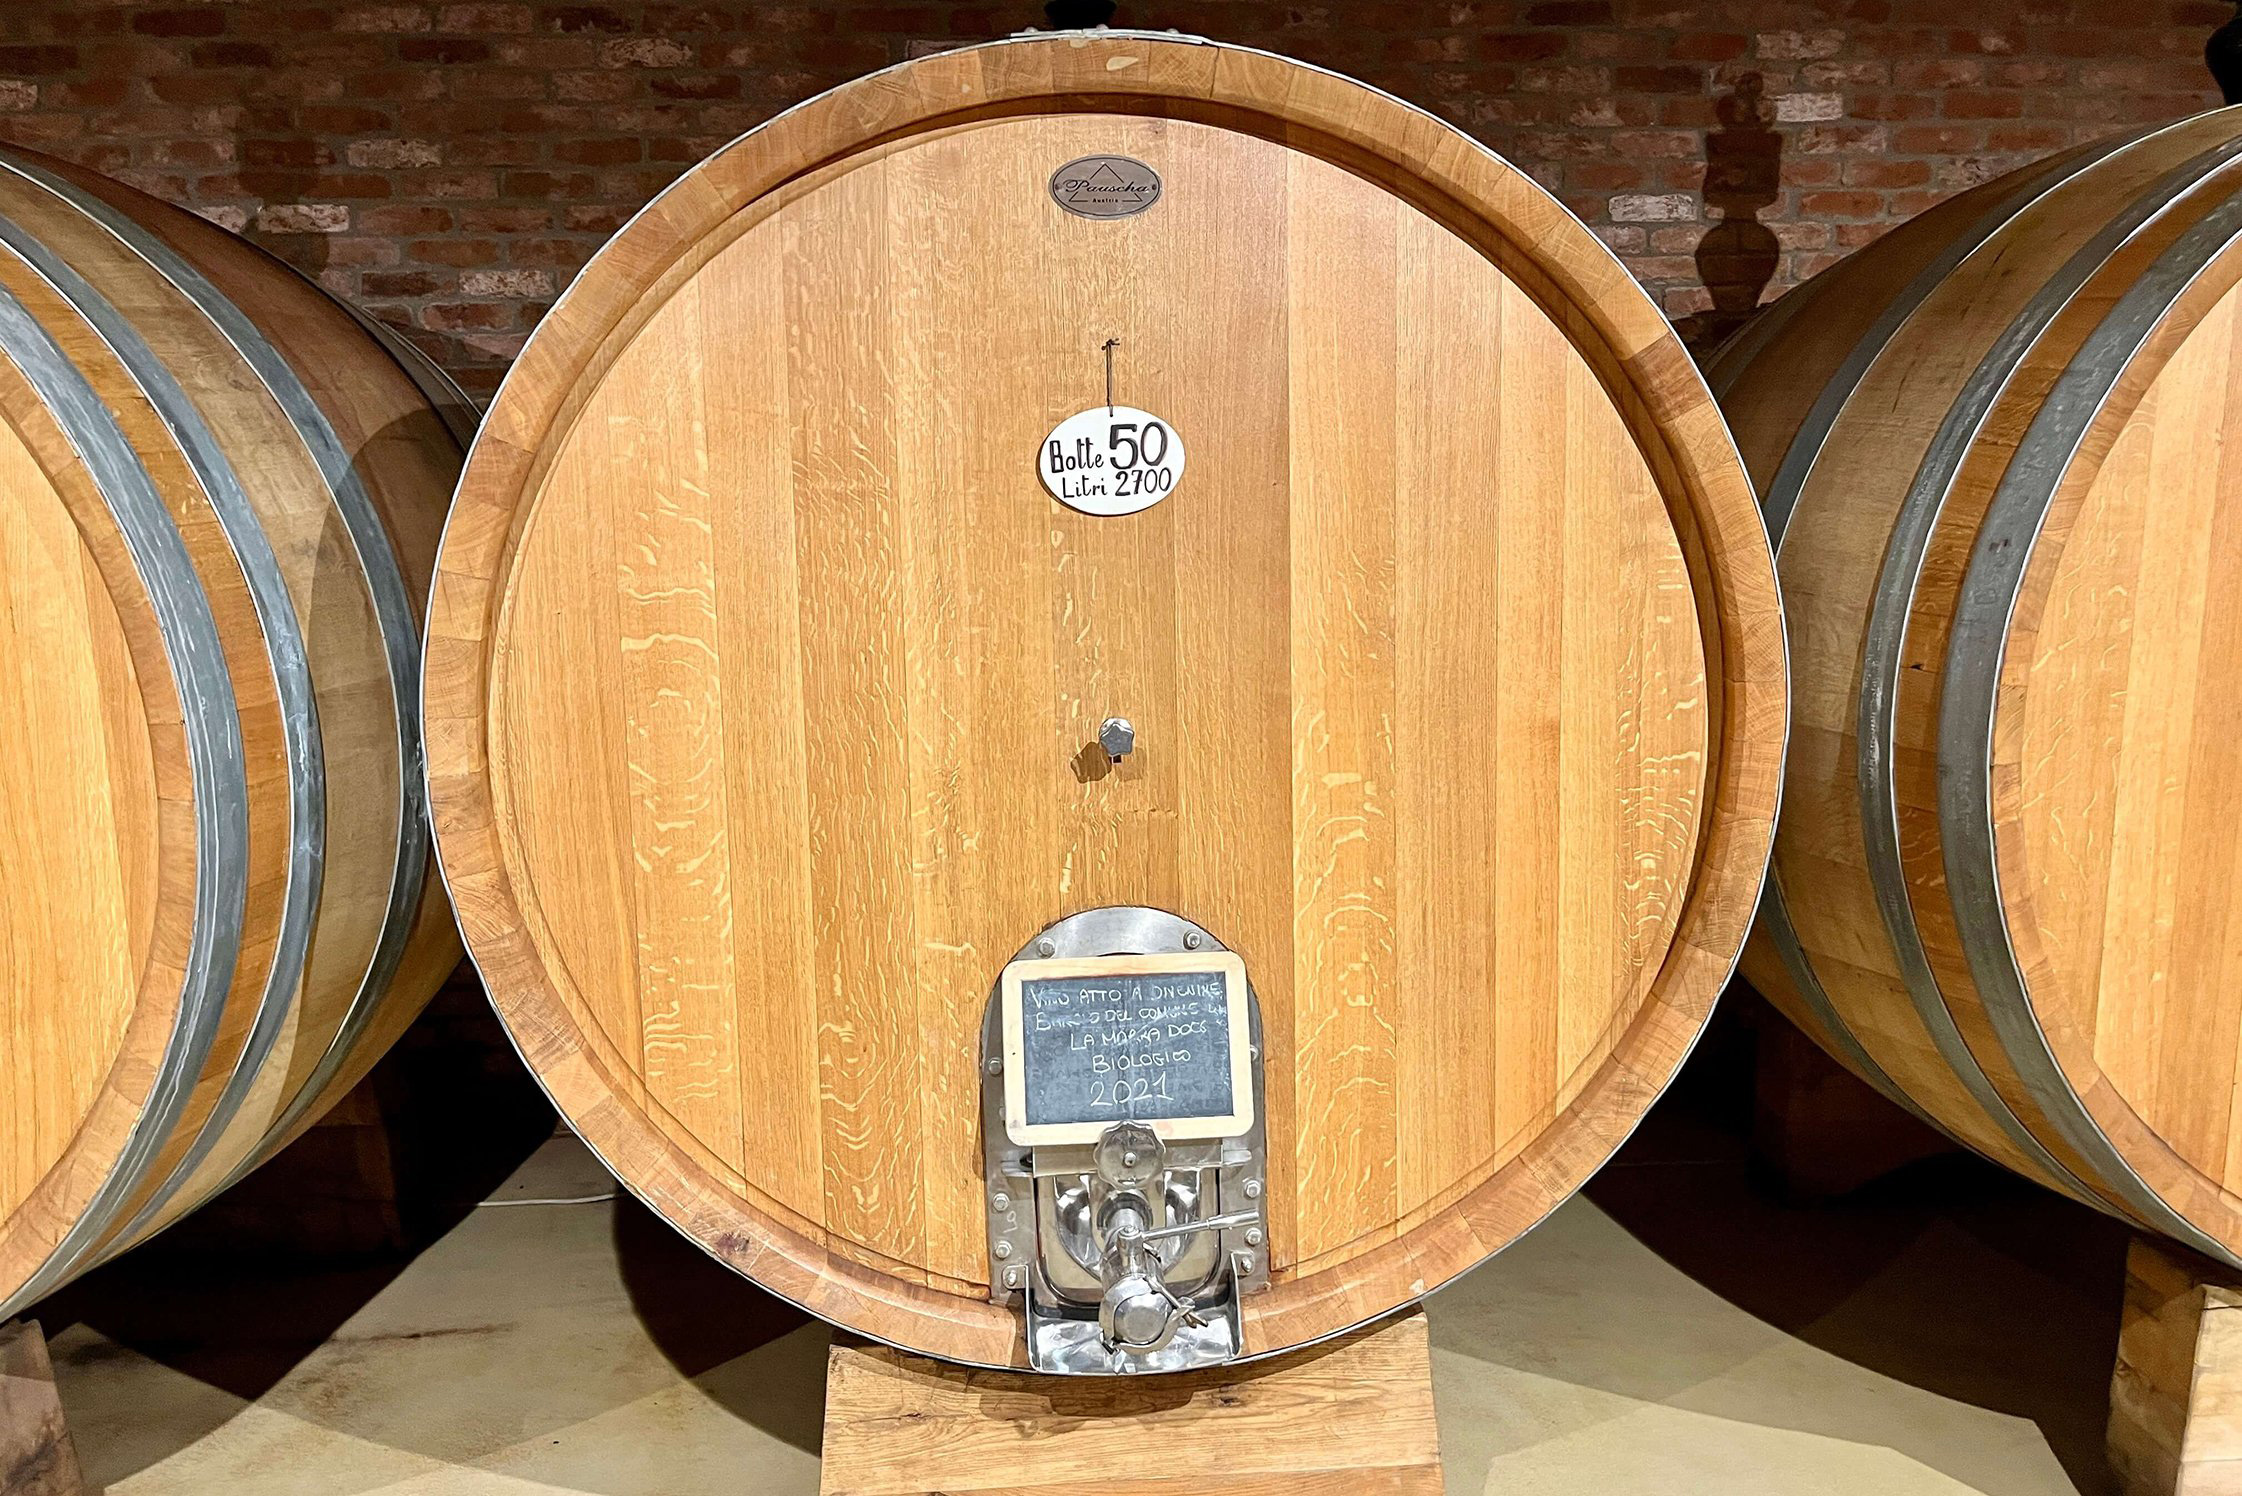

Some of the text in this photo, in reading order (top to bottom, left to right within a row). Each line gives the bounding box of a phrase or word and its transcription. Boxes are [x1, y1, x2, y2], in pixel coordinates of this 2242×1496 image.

[1063, 179, 1149, 193] Pauscha
[1049, 422, 1168, 474] Botte 50
[1062, 467, 1172, 499] Litri 2700
[1079, 987, 1122, 1005] ATTO
[1133, 985, 1143, 1002] A
[1105, 1009, 1133, 1023] DEL
[1070, 1033, 1095, 1051] LA
[1168, 1020, 1208, 1038] DOCG
[1092, 1049, 1191, 1074] BIOLOGICO
[1090, 1071, 1174, 1107] 2021
